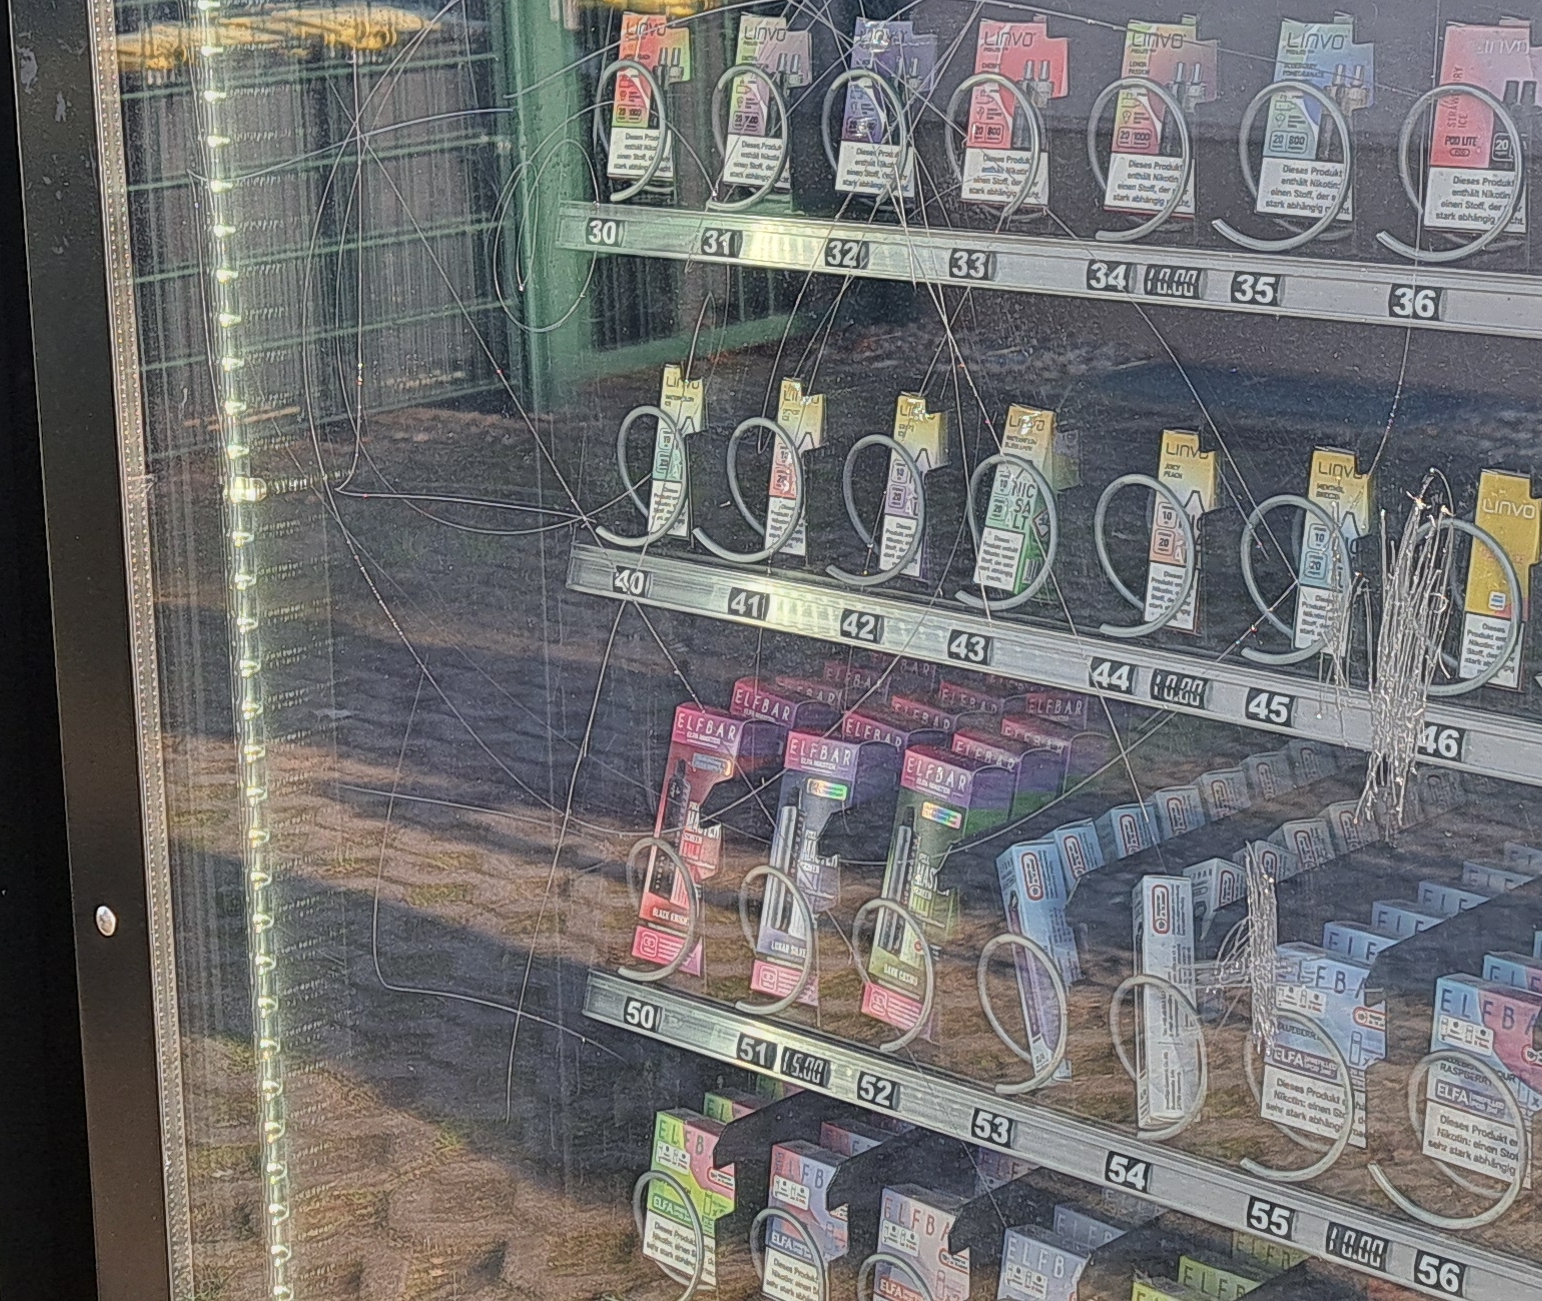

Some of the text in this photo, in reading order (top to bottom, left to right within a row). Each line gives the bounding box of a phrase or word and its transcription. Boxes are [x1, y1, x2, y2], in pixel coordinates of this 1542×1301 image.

[589, 221, 616, 244] 30
[704, 230, 731, 255] 31
[828, 242, 858, 267] 32
[953, 251, 986, 277] 33
[1089, 264, 1126, 289] 34
[1233, 274, 1275, 303] 35
[1391, 288, 1437, 318] 36
[614, 570, 643, 594] 40
[732, 591, 761, 616] 41
[843, 613, 875, 639] 42
[950, 633, 985, 661] 43
[1093, 663, 1129, 690] 44
[1249, 693, 1290, 722] 45
[676, 712, 737, 743] ELFBAR
[1422, 725, 1459, 757] 46
[789, 736, 852, 766] ELFBAR
[906, 756, 969, 792] ELFBAR
[626, 1002, 655, 1029] 50
[739, 1037, 768, 1066] 51
[1273, 1049, 1303, 1067] ELFA
[861, 1075, 893, 1105] 52
[1436, 1082, 1469, 1106] ELFA
[973, 1113, 1009, 1142] 53
[1108, 1159, 1146, 1190] 54
[1250, 1202, 1292, 1236] 55
[1417, 1259, 1460, 1291] 56
